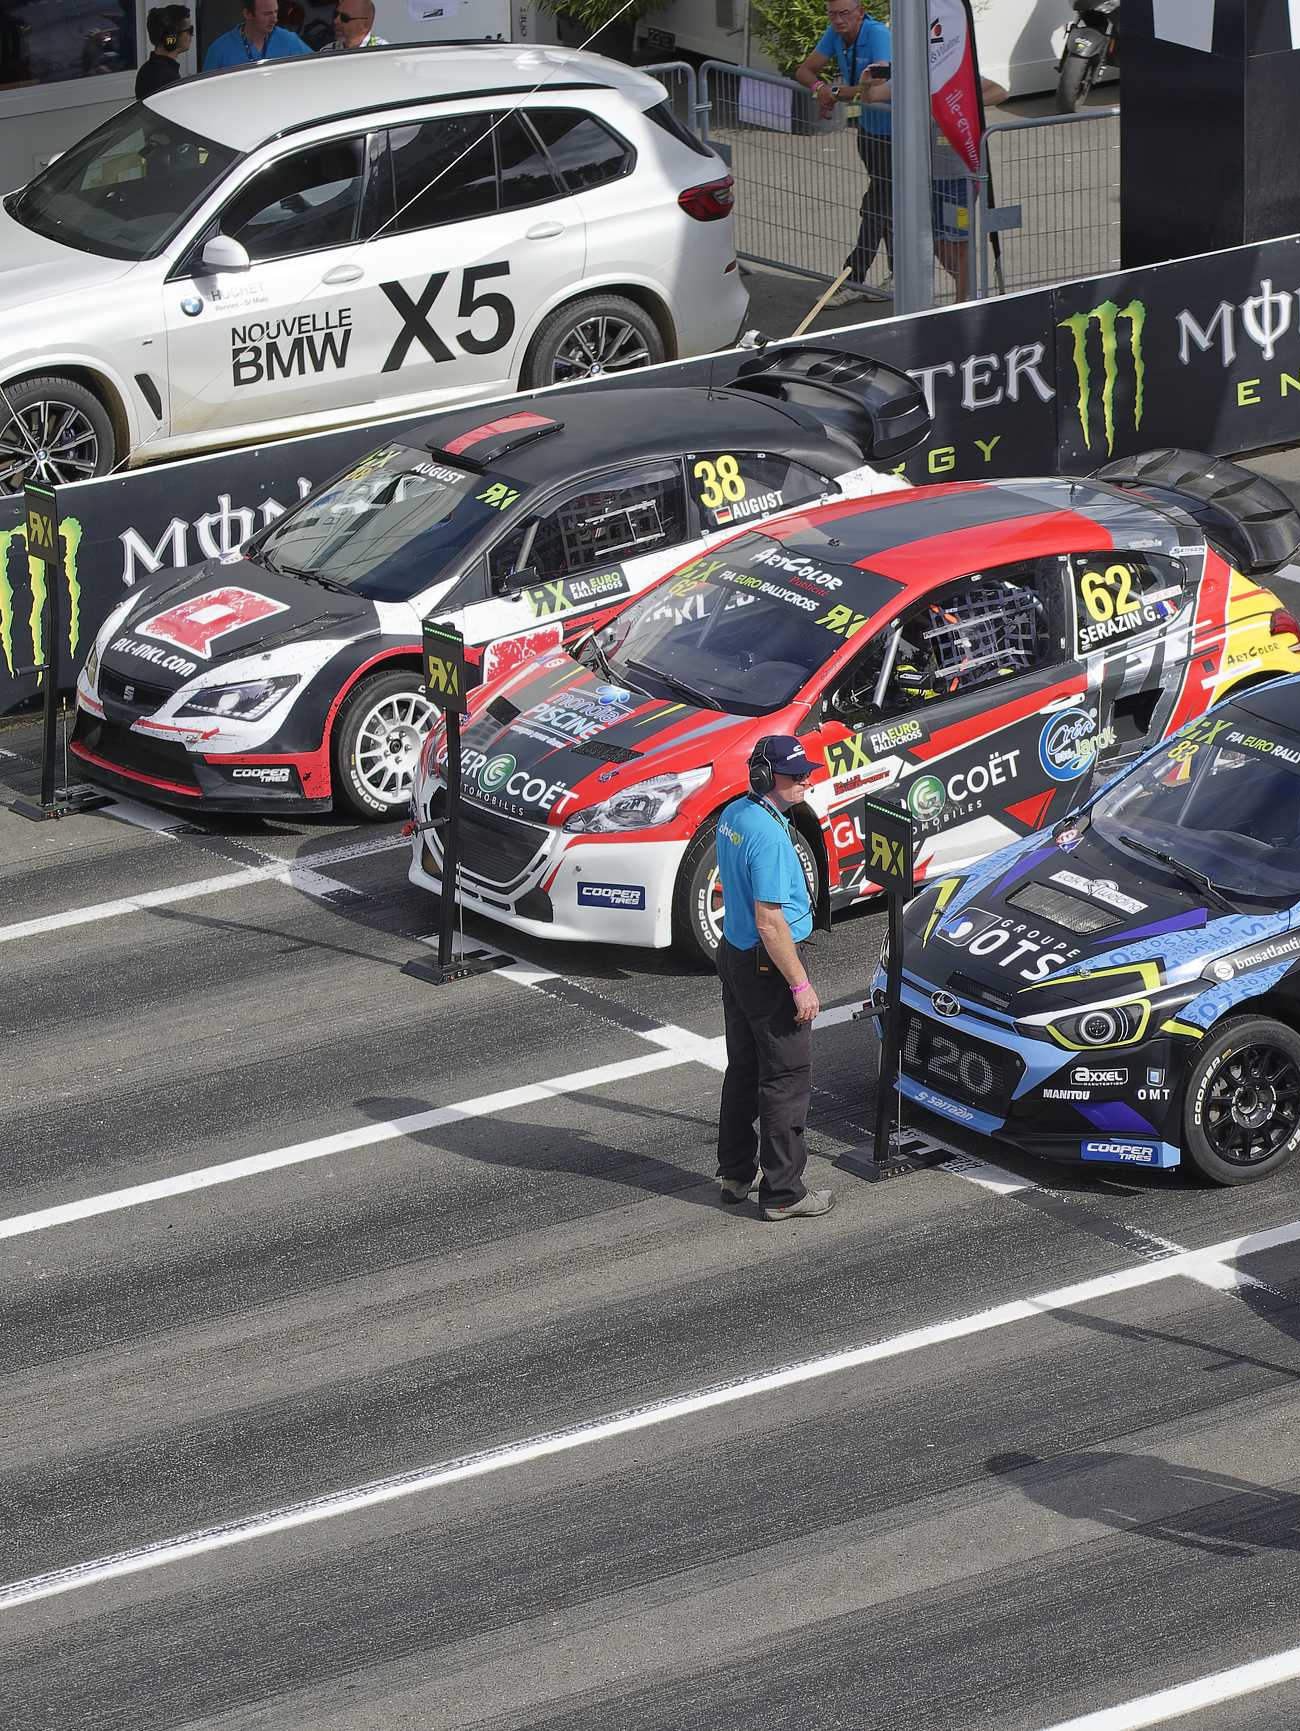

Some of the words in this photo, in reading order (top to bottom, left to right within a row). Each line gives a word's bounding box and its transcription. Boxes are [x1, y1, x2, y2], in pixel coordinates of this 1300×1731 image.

[231, 307, 352, 346] NOUVELLE
[379, 260, 516, 374] X5
[231, 328, 352, 387] BMW
[411, 463, 466, 484] AUGUST
[694, 455, 745, 508] 38
[732, 490, 783, 520] AUGUST
[573, 580, 623, 599] RALLYCROSS
[719, 570, 737, 581] FIA
[735, 574, 762, 588] EURO
[759, 581, 820, 611] RALLYCROSS
[1081, 565, 1141, 622] 62
[1079, 612, 1143, 646] SERAZIN
[1143, 606, 1161, 624] G.
[873, 731, 923, 753] RALLYCROSS
[1167, 740, 1199, 763] 83
[1226, 731, 1244, 743] FIA
[1243, 735, 1273, 754] EURO
[233, 768, 290, 781] COOPER
[946, 749, 1021, 801] COËT
[463, 782, 525, 816] TOMOBILES
[506, 771, 580, 814] COËT
[582, 887, 641, 900] COOPER
[609, 896, 640, 905] TIRES
[968, 928, 1066, 983] OTS
[1001, 919, 1081, 960] GROUPE
[1043, 1089, 1090, 1100] MANITOU
[1194, 1055, 1221, 1126] COOPER
[1087, 1143, 1153, 1155] COOPER
[1119, 1153, 1152, 1162] TIRES
